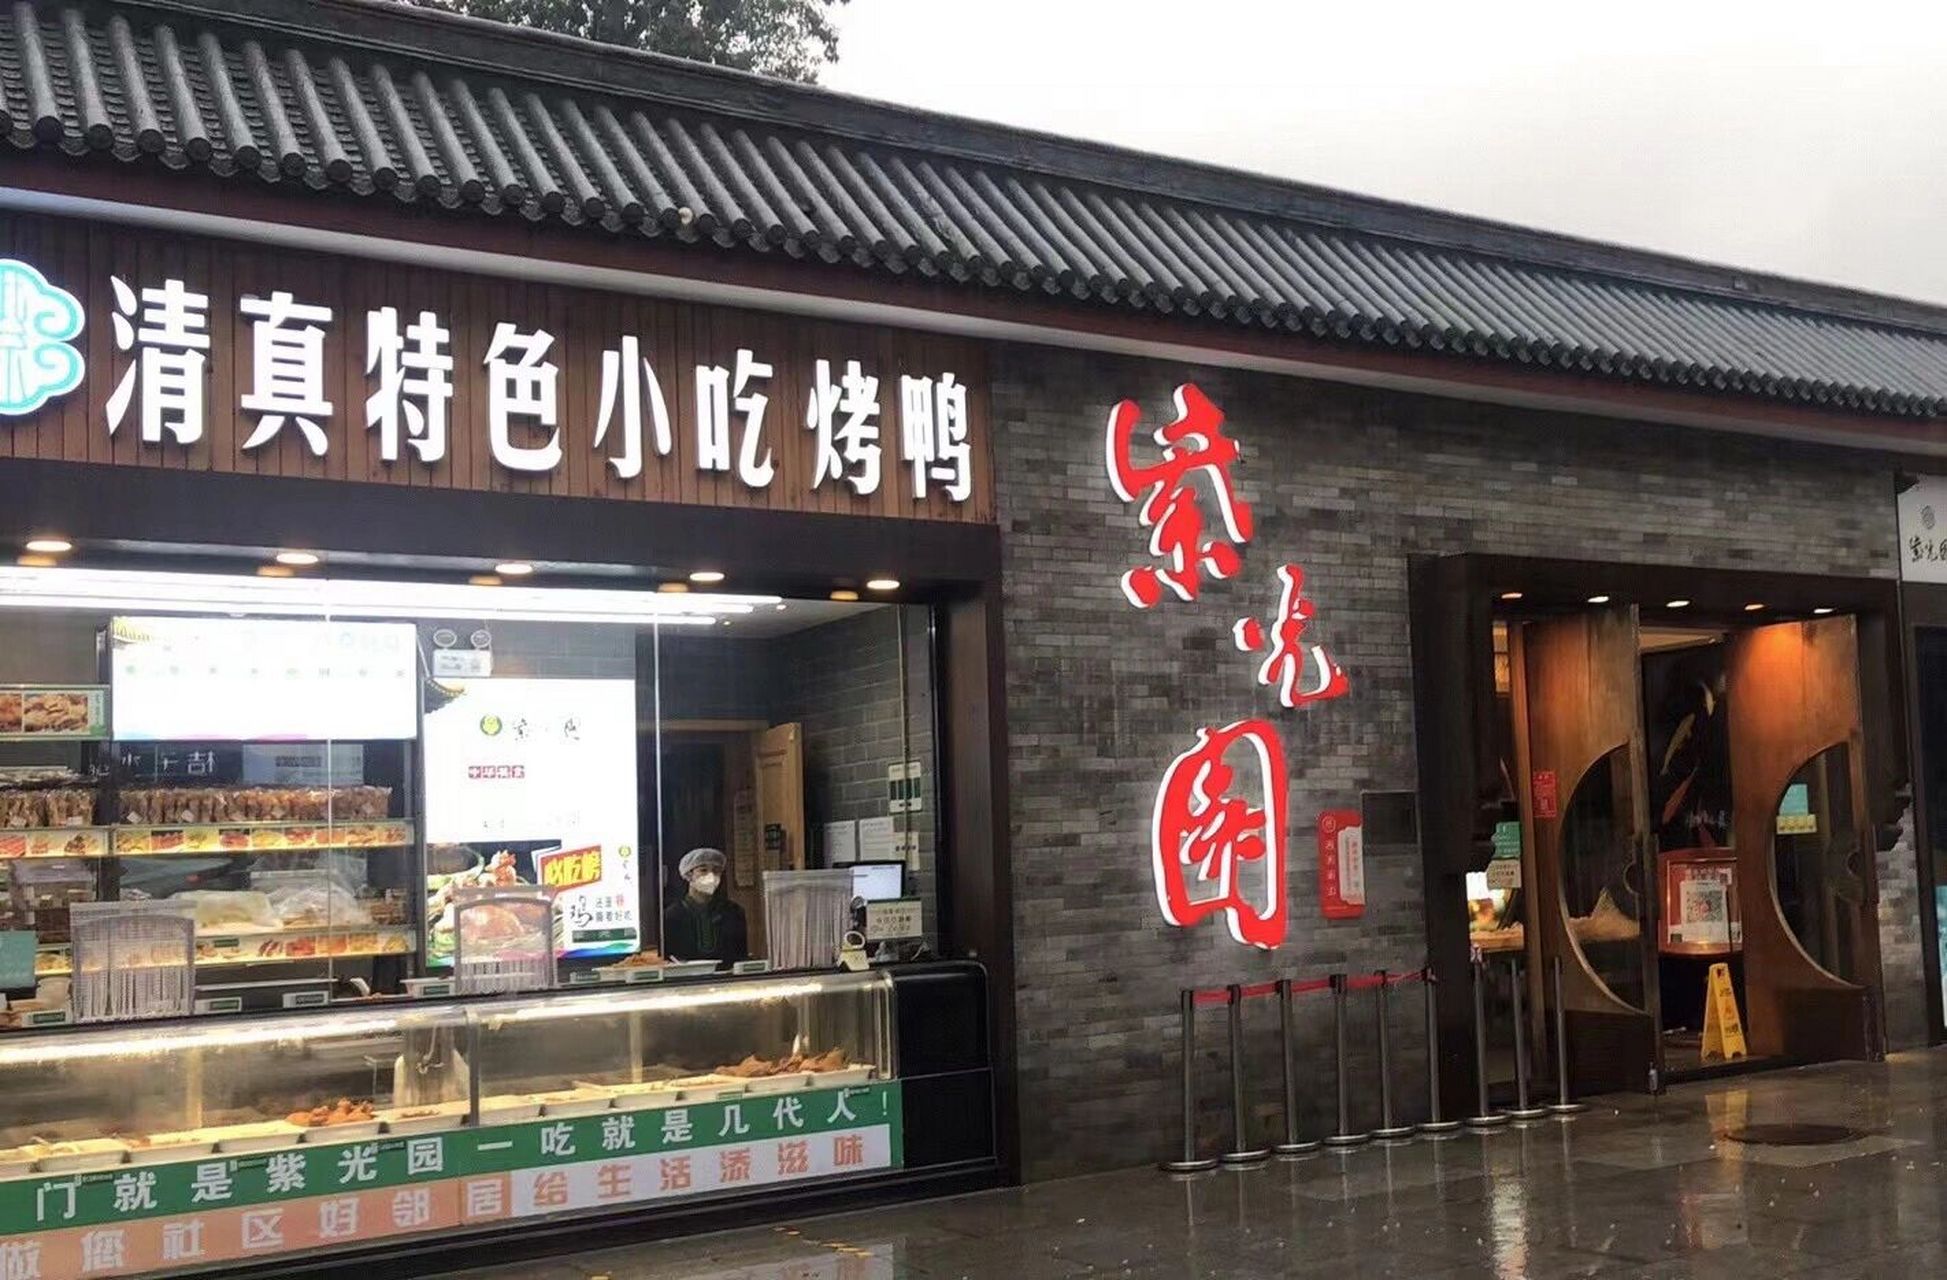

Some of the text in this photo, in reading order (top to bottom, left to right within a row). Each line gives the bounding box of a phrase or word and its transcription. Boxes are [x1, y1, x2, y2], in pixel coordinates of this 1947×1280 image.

[106, 275, 972, 502] 清真特色小吃烤鸭
